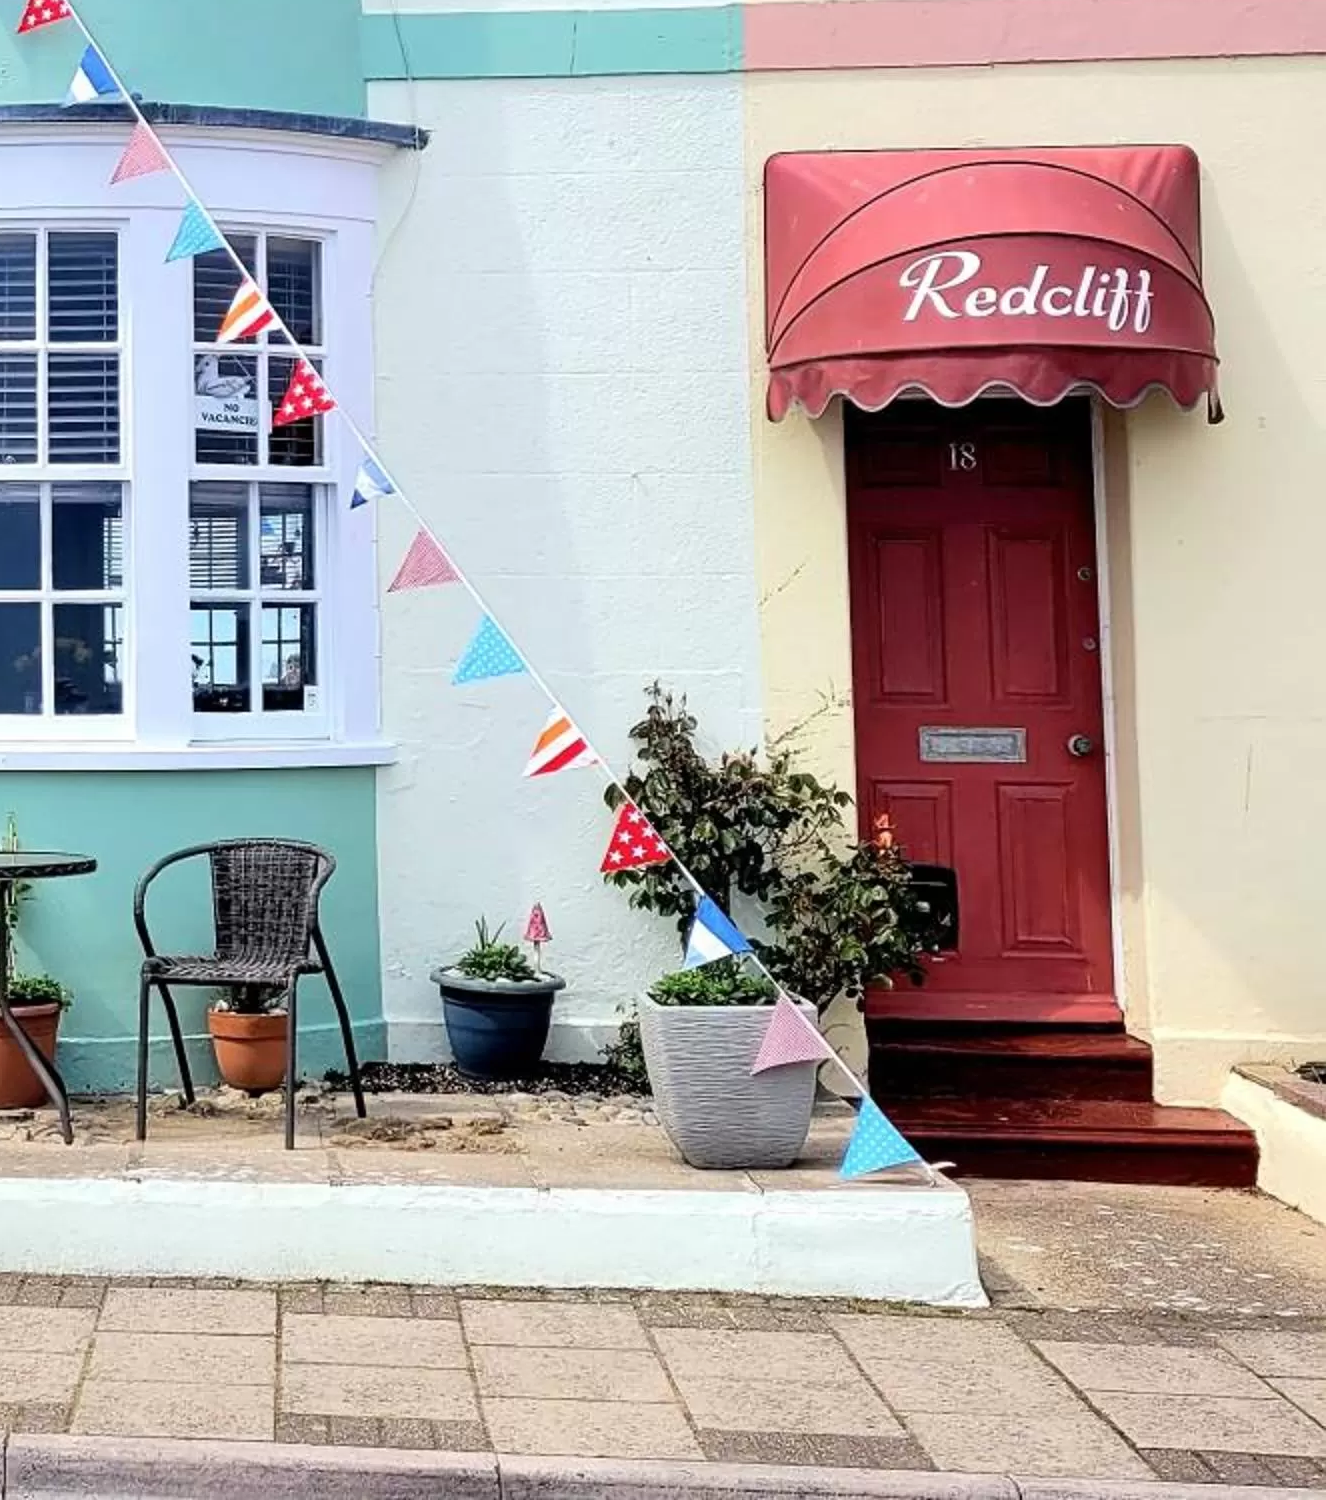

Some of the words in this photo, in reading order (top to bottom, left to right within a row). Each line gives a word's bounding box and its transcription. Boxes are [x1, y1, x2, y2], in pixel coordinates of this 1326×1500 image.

[899, 251, 1154, 333] Redcliff
[201, 412, 258, 426] VACANCIE
[224, 403, 240, 413] NO
[948, 442, 978, 472] 18
